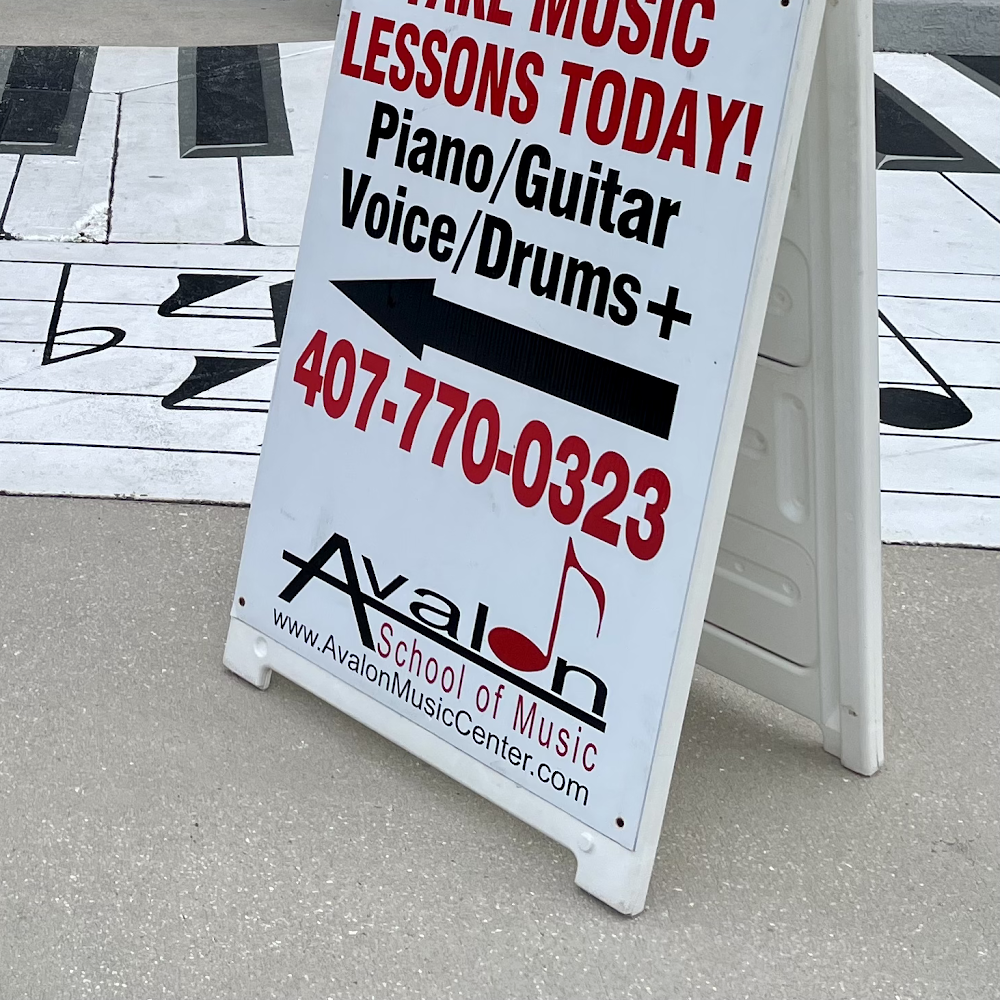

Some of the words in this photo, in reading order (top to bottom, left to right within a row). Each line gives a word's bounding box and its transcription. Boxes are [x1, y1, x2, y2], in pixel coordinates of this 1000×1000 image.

[340, 11, 544, 125] LESSONS
[559, 60, 764, 182] TODAY!
[366, 100, 681, 249] Piano/Guitar
[294, 329, 671, 561] 407-770-0323
[273, 608, 590, 806] www.AvalonMusicCenter.com
[278, 532, 609, 722] Avalon
[377, 622, 465, 699] School
[476, 684, 505, 719] of
[513, 694, 598, 772] Music
